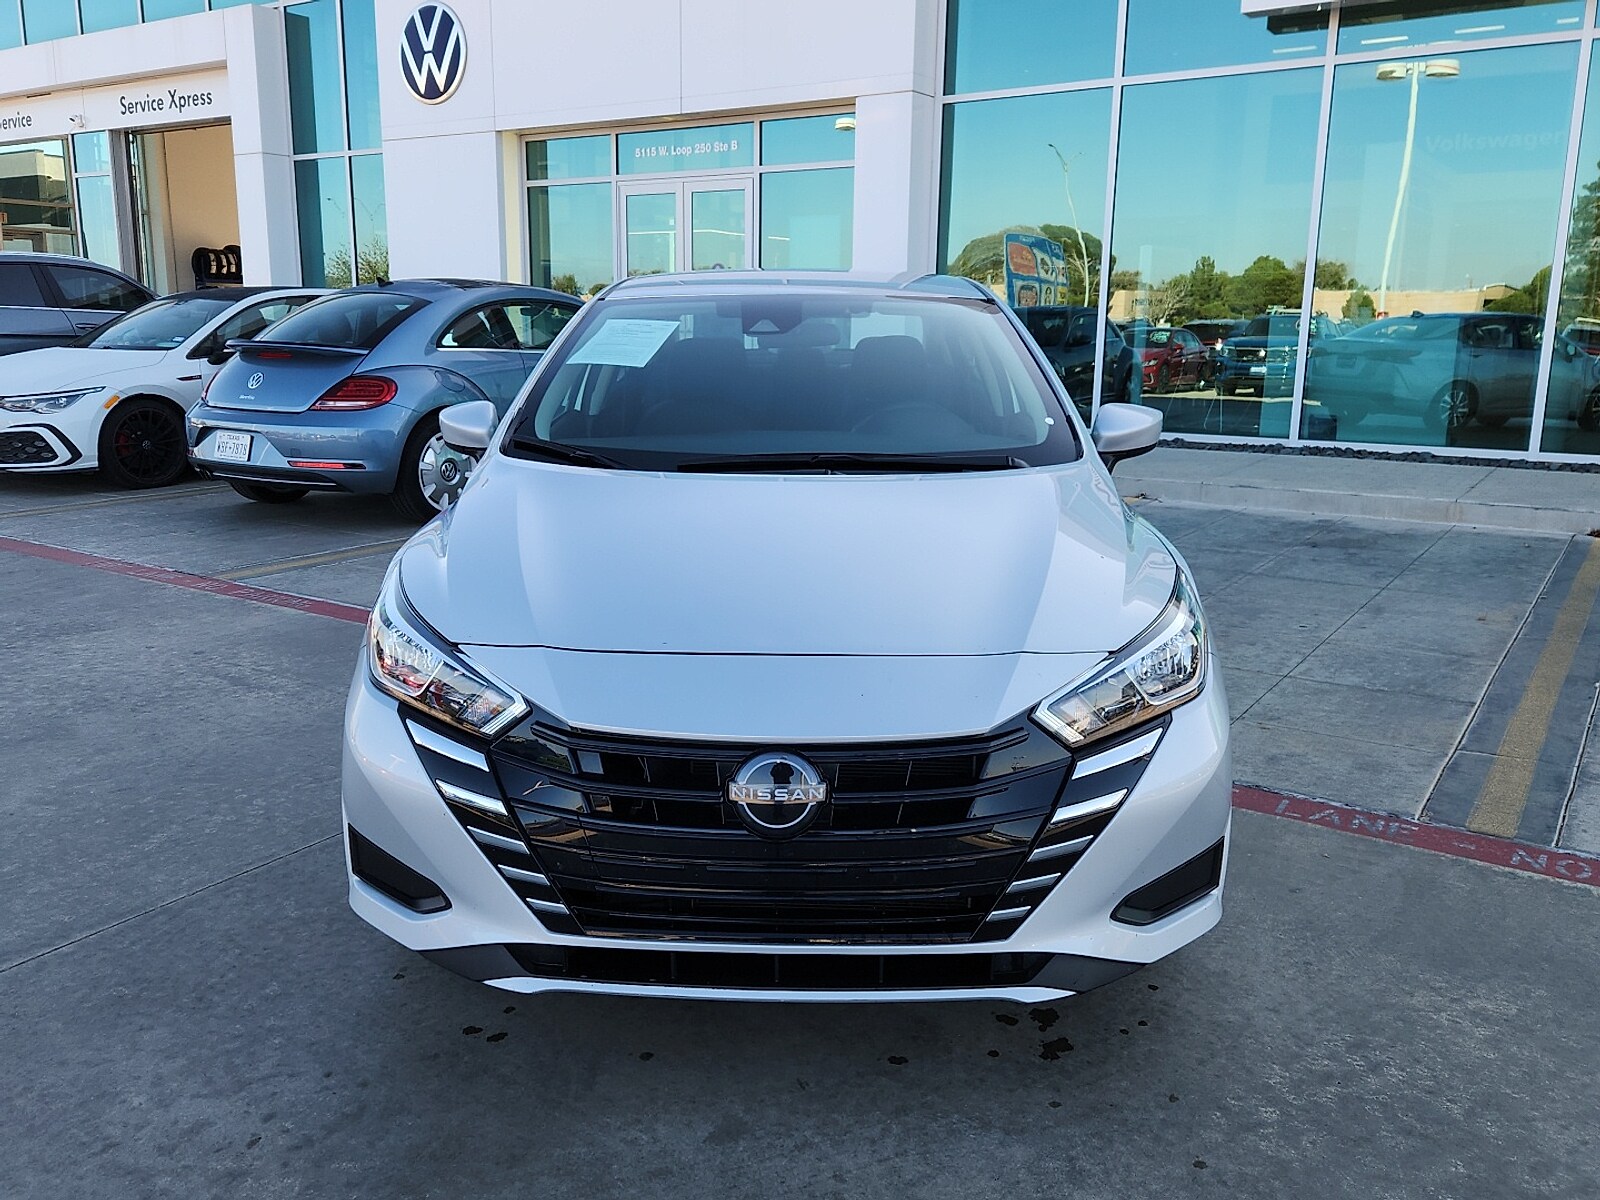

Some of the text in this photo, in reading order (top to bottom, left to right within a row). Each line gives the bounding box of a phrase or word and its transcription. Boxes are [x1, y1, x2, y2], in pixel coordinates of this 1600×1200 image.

[120, 89, 213, 115] Service Xpress
[0, 111, 32, 130] ervice
[635, 140, 738, 158] 5115 W. Loop 250 Ste B
[731, 786, 824, 801] NISSAN
[1510, 848, 1592, 879] NO
